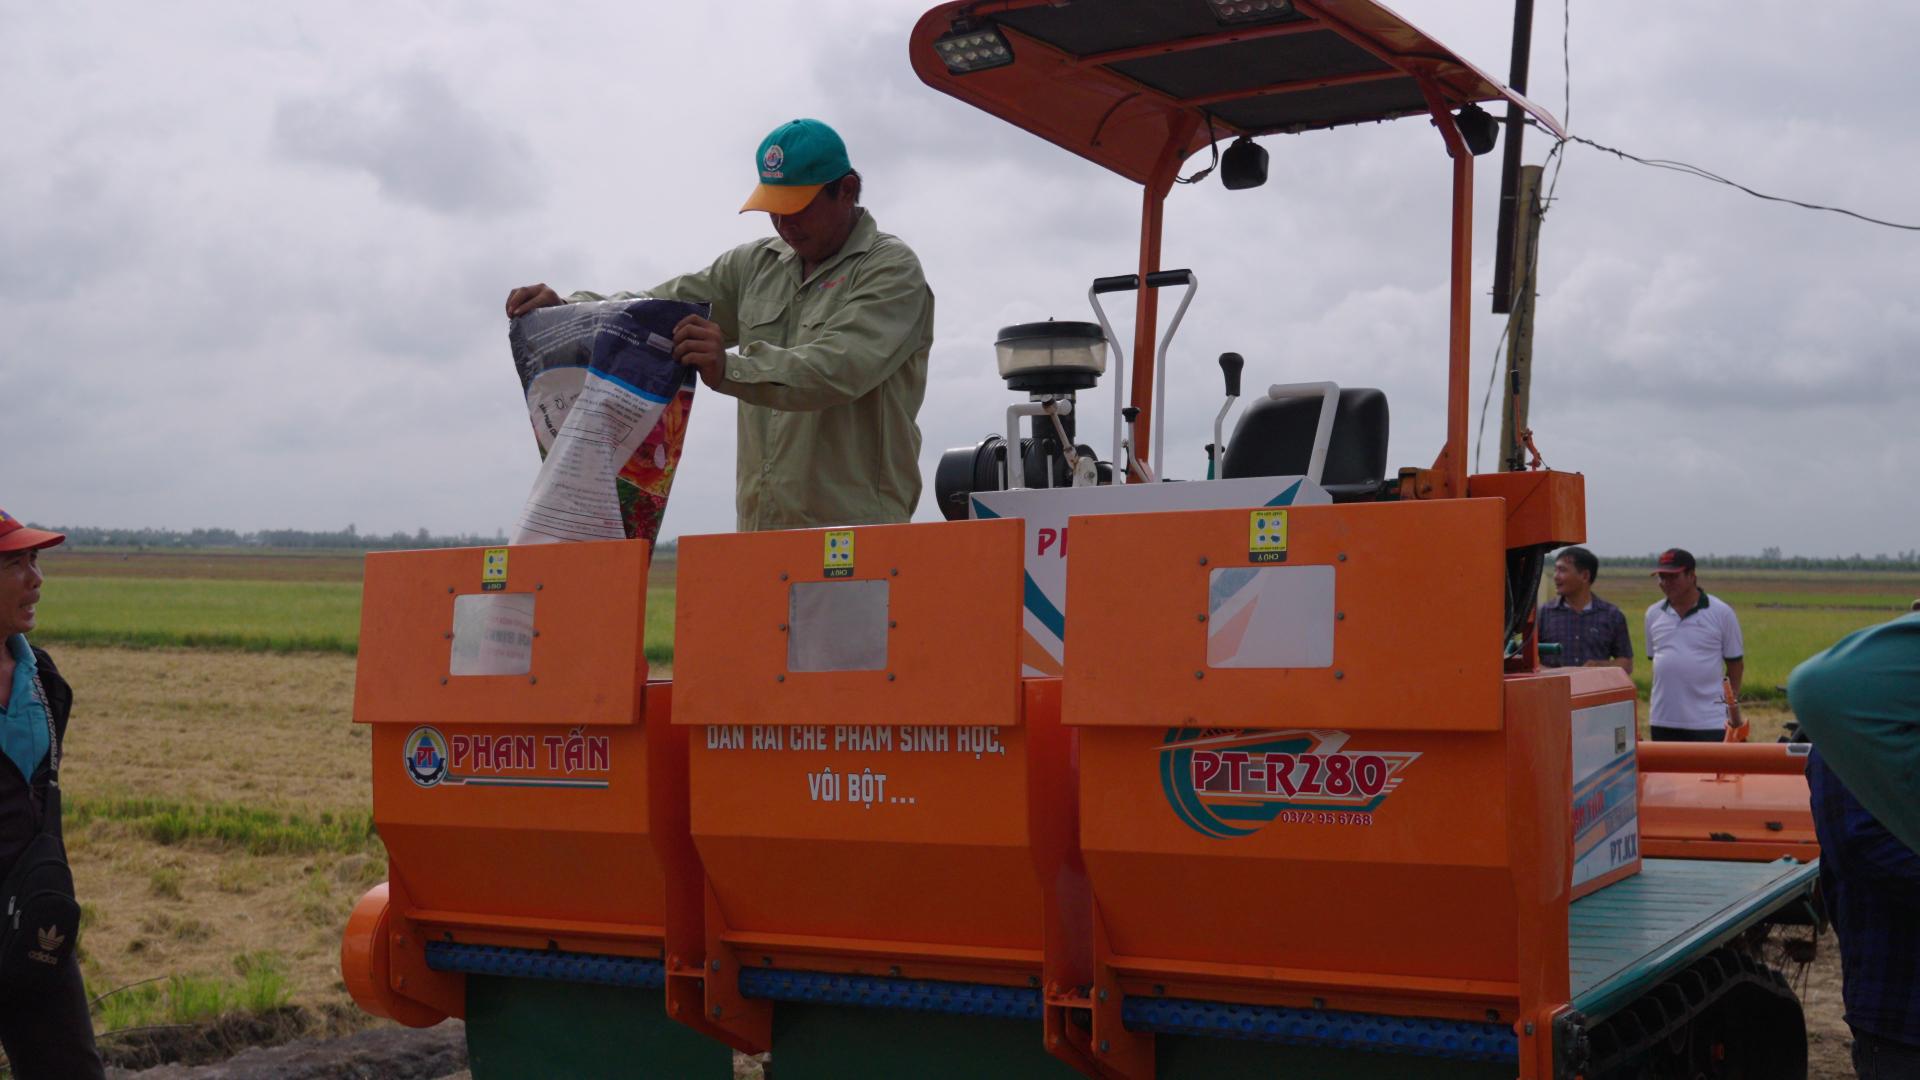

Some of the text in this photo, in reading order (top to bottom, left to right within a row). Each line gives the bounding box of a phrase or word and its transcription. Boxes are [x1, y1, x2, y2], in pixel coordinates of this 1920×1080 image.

[451, 735, 536, 773] PHAN
[899, 726, 949, 752] SINH
[957, 726, 1005, 760] HỌC,
[807, 766, 840, 801] VÔI
[848, 767, 887, 809] BỘT
[1192, 750, 1388, 799] PT-R280
[27, 950, 58, 965] adidas
